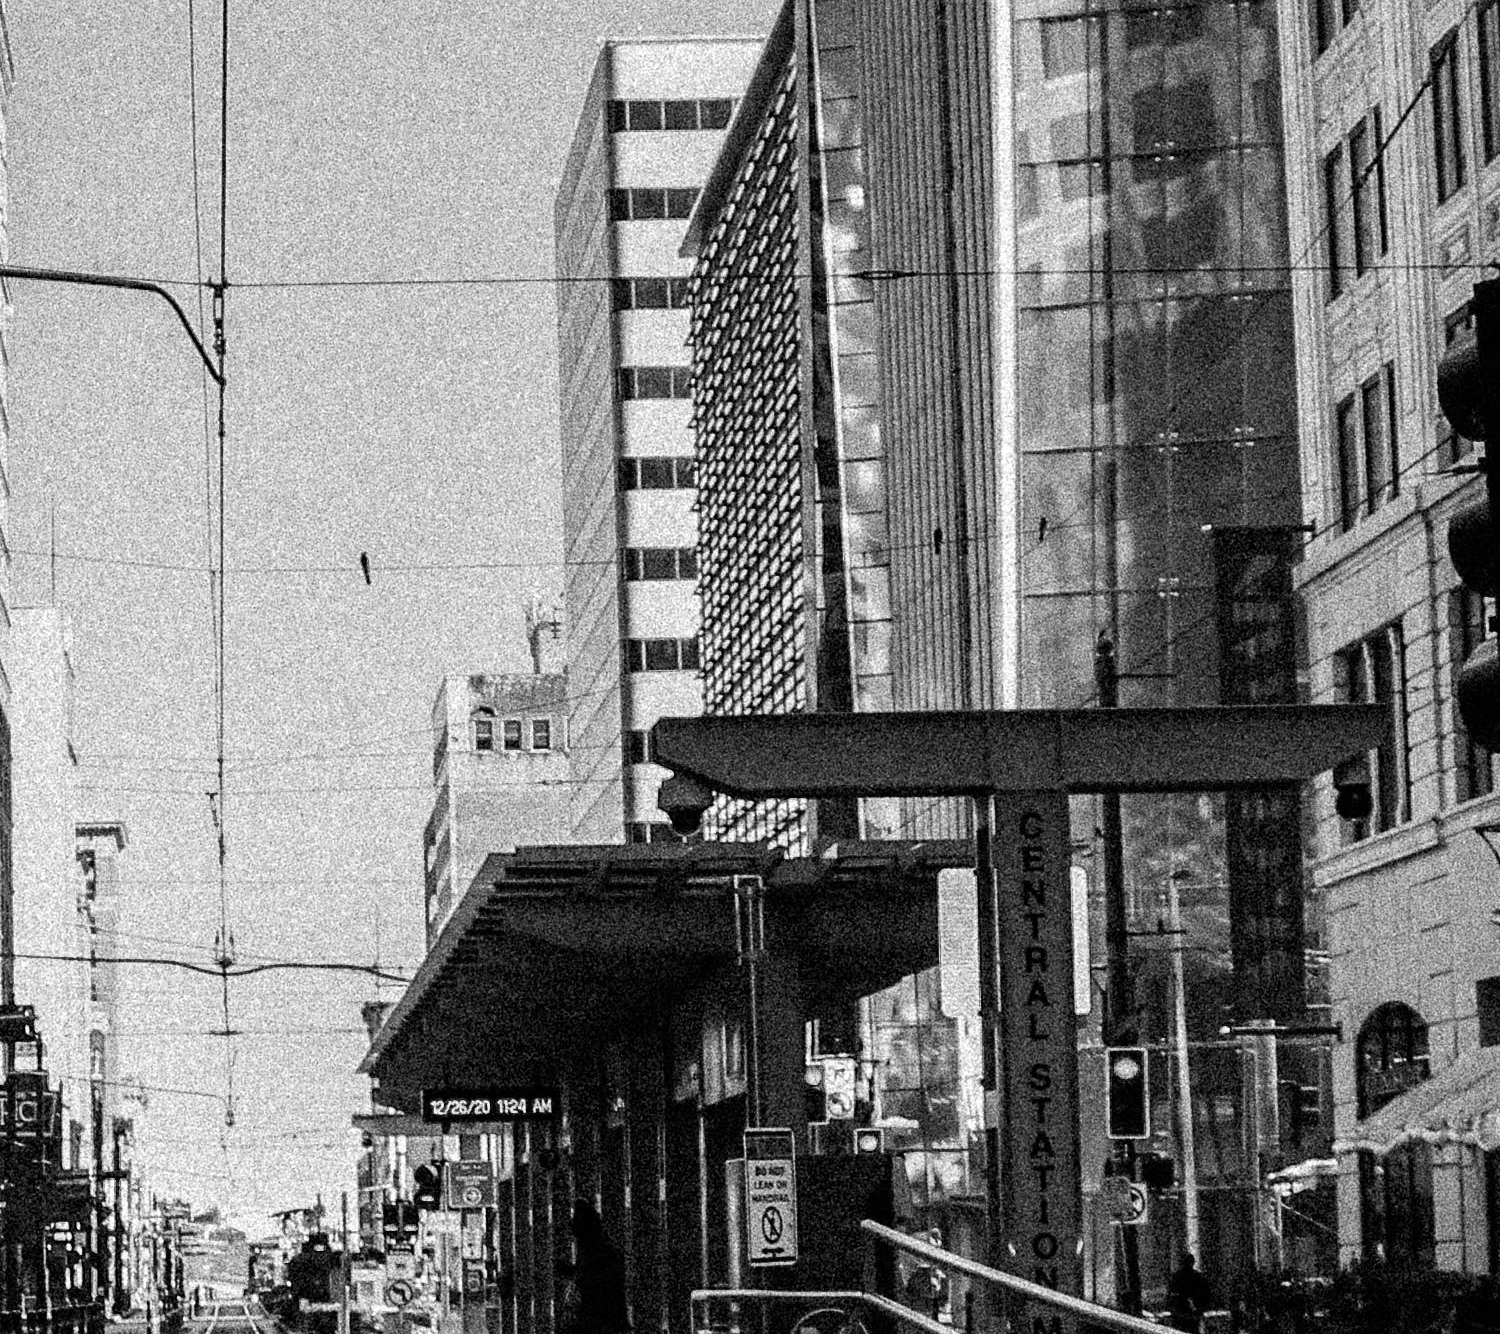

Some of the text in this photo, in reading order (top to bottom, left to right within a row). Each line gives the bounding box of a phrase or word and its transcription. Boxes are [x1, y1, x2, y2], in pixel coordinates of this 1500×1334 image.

[1020, 812, 1051, 1040] CENTRAL
[429, 1099, 491, 1116] 12/26/20
[532, 1098, 553, 1114] AM
[1030, 1064, 1059, 1292] STATION
